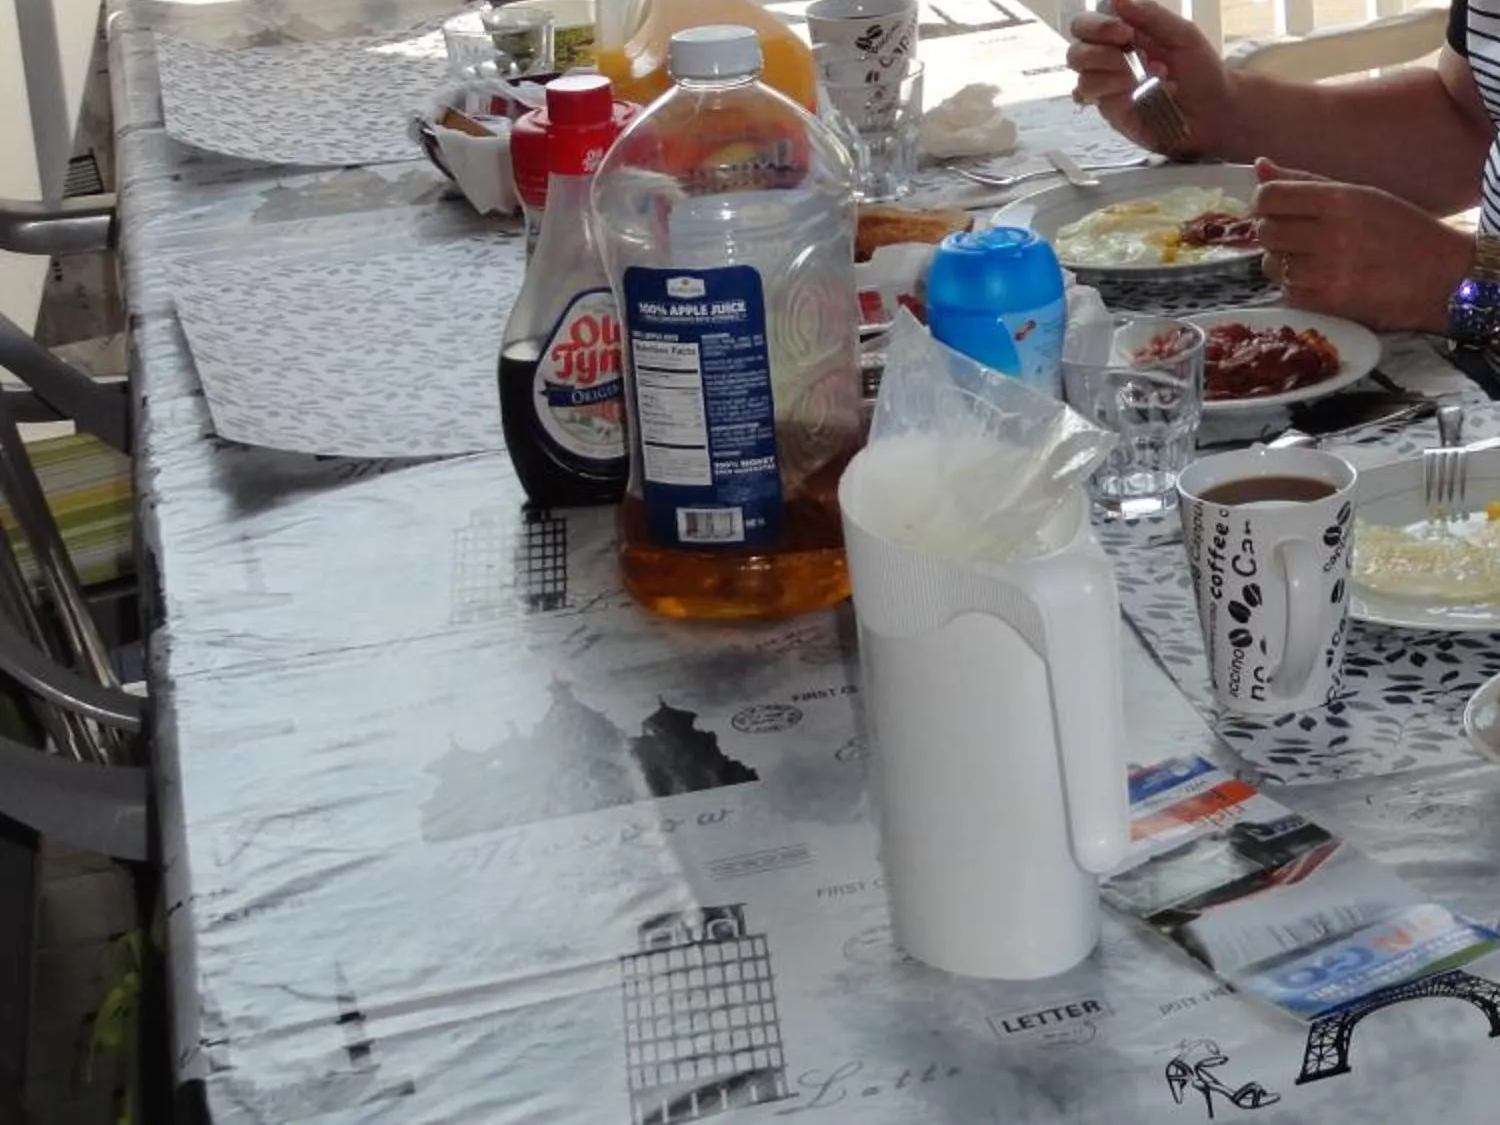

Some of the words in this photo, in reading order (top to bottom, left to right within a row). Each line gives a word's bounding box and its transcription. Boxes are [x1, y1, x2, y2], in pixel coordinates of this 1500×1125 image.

[669, 304, 709, 316] APPLE
[711, 299, 747, 315] JUICE
[1207, 521, 1230, 600] coffee
[1001, 999, 1103, 1034] LETTER
